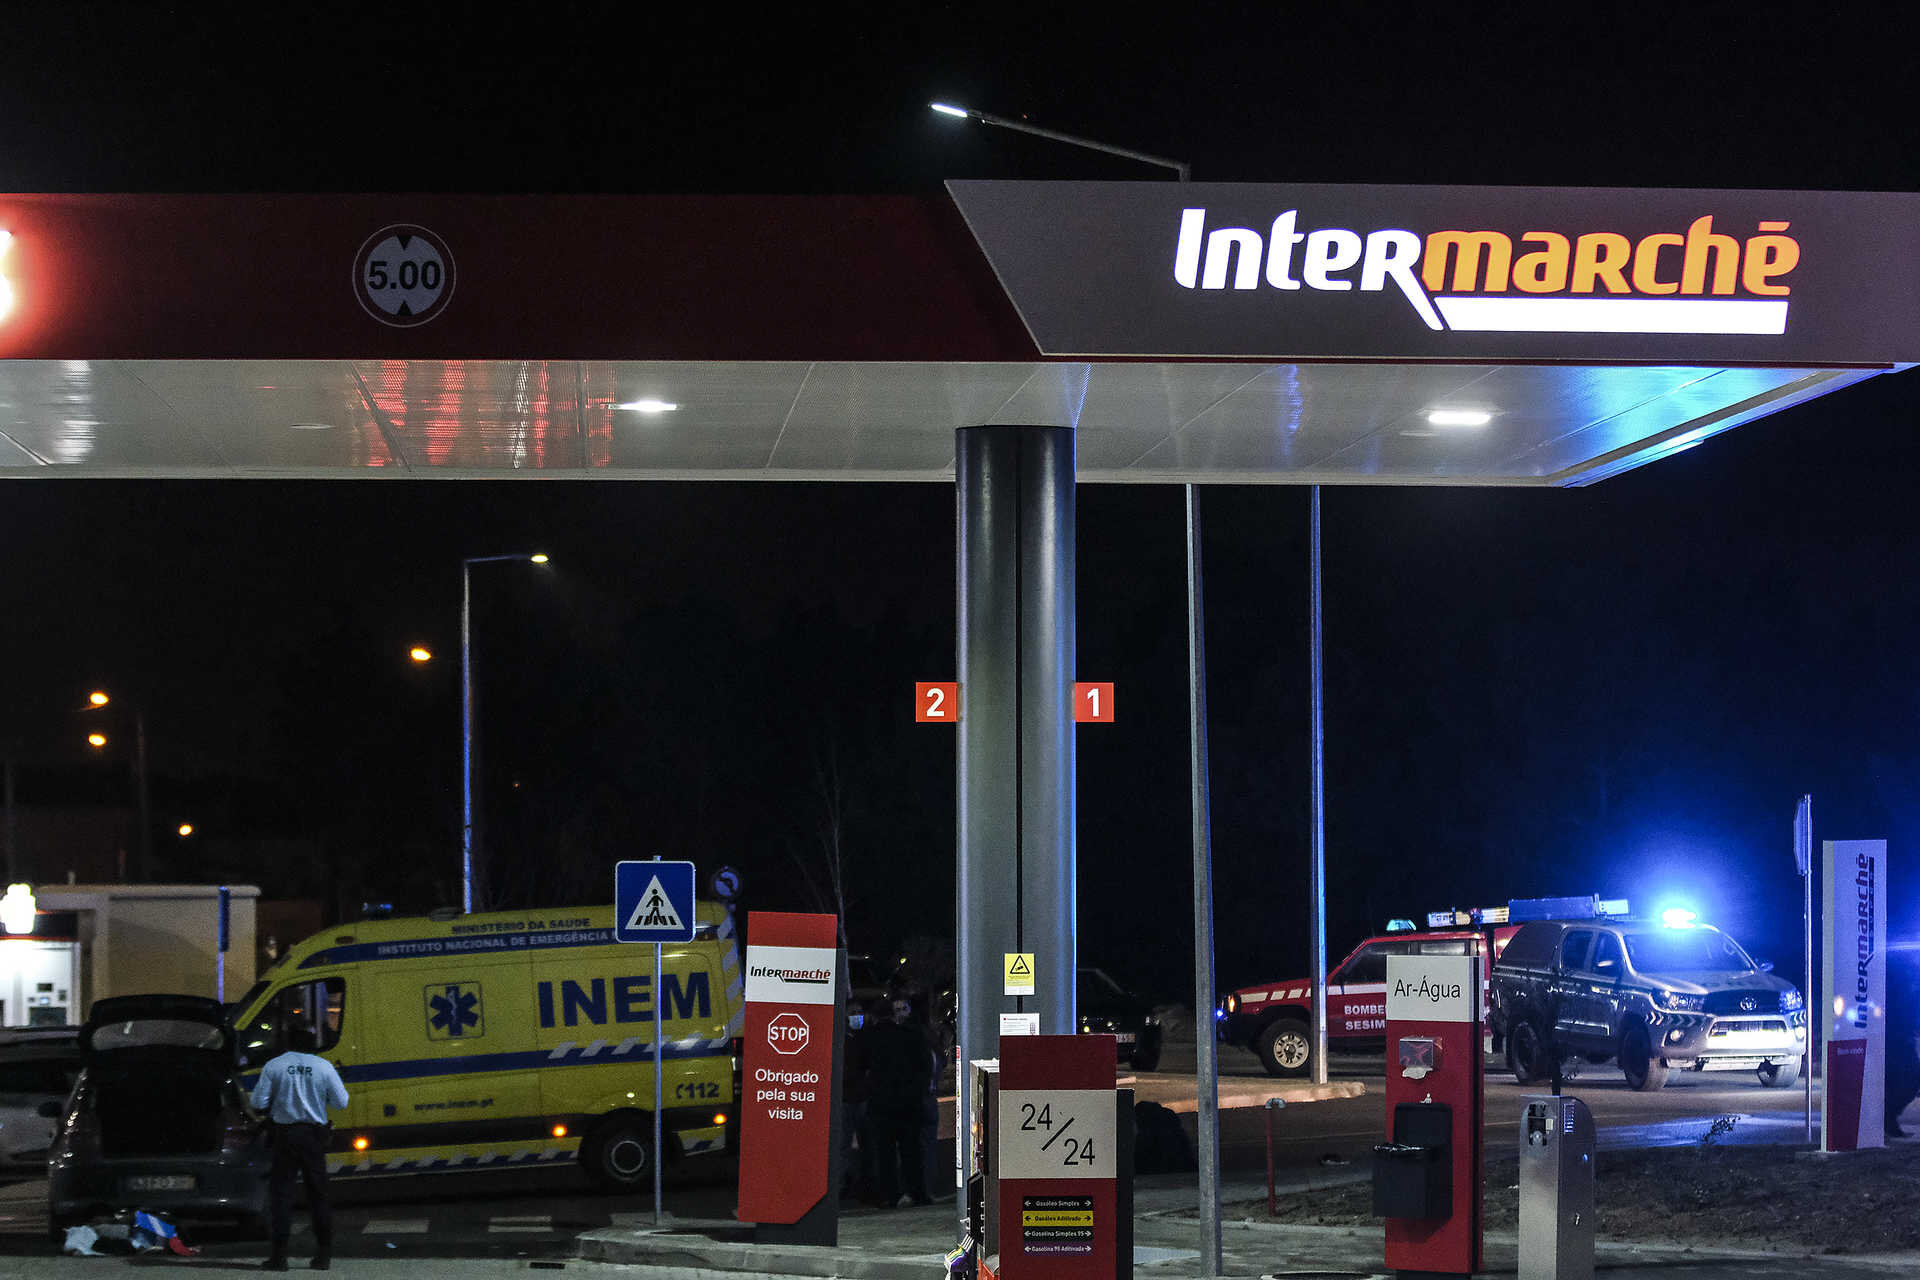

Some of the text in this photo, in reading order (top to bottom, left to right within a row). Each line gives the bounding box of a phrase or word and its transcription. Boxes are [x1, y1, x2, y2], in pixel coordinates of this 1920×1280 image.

[368, 260, 440, 290] 5.00
[1174, 208, 1800, 331] Intermarché
[926, 687, 945, 717] 2
[1087, 687, 1100, 717] 1
[527, 920, 546, 931] DA
[378, 940, 442, 956] INSTITUTO
[445, 936, 507, 951] NACIONAL
[510, 934, 527, 947] DE
[1854, 853, 1874, 1029] Intermarché
[750, 966, 831, 983] Intermarché
[1394, 975, 1461, 1002] Ar-Água
[537, 971, 712, 1029] INEM
[769, 1026, 807, 1042] STOP
[755, 1068, 819, 1086] Obrigado
[683, 1081, 720, 1100] 112
[757, 1087, 815, 1103] pela sua
[768, 1106, 803, 1120] visita
